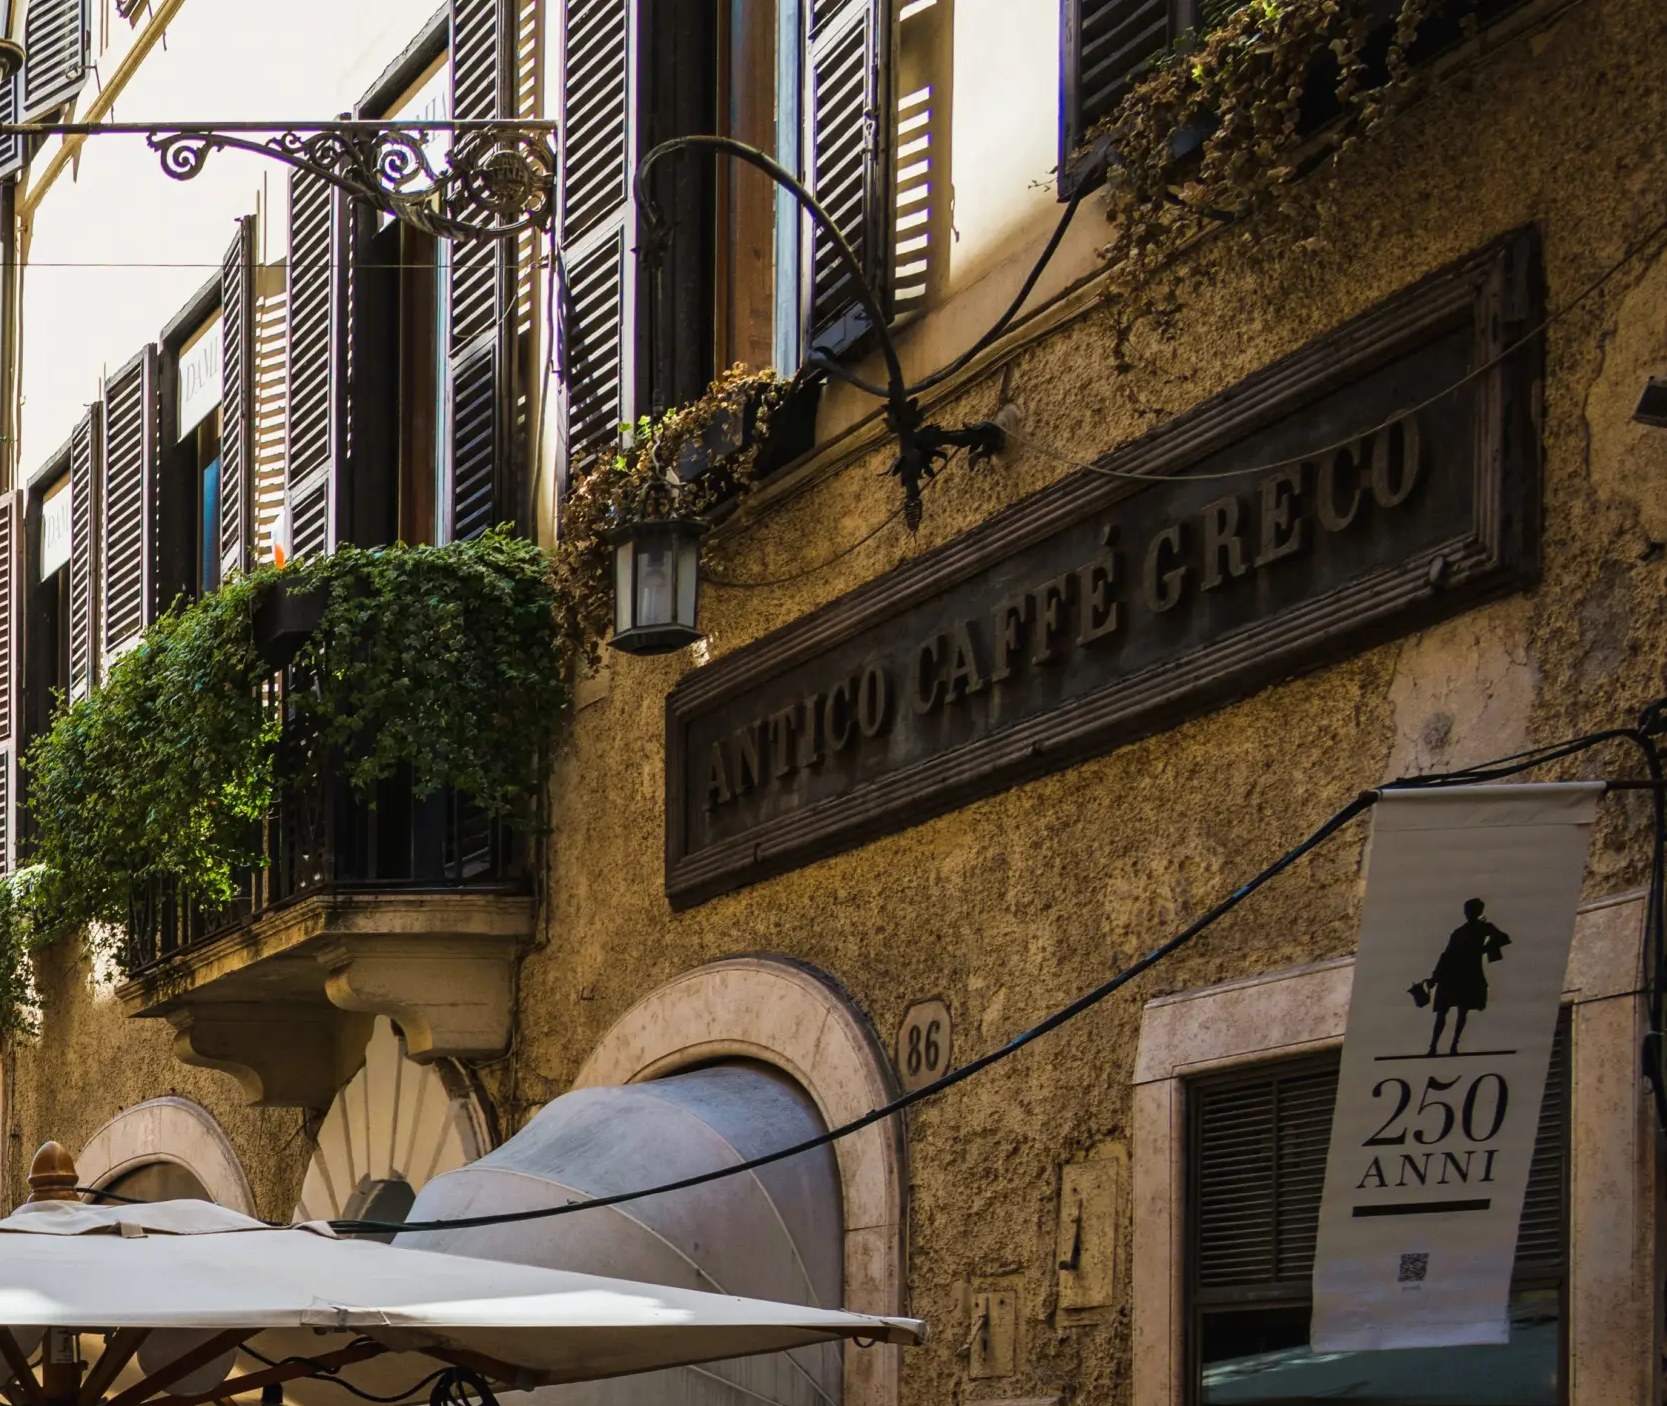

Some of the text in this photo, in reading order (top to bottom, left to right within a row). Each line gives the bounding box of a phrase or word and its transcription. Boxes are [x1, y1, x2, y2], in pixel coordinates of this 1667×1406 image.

[704, 664, 885, 813] ANTICO
[1144, 409, 1420, 612] GRECO
[906, 1020, 941, 1078] 86
[1361, 1073, 1509, 1147] 250
[1355, 1150, 1500, 1188] ANNI
